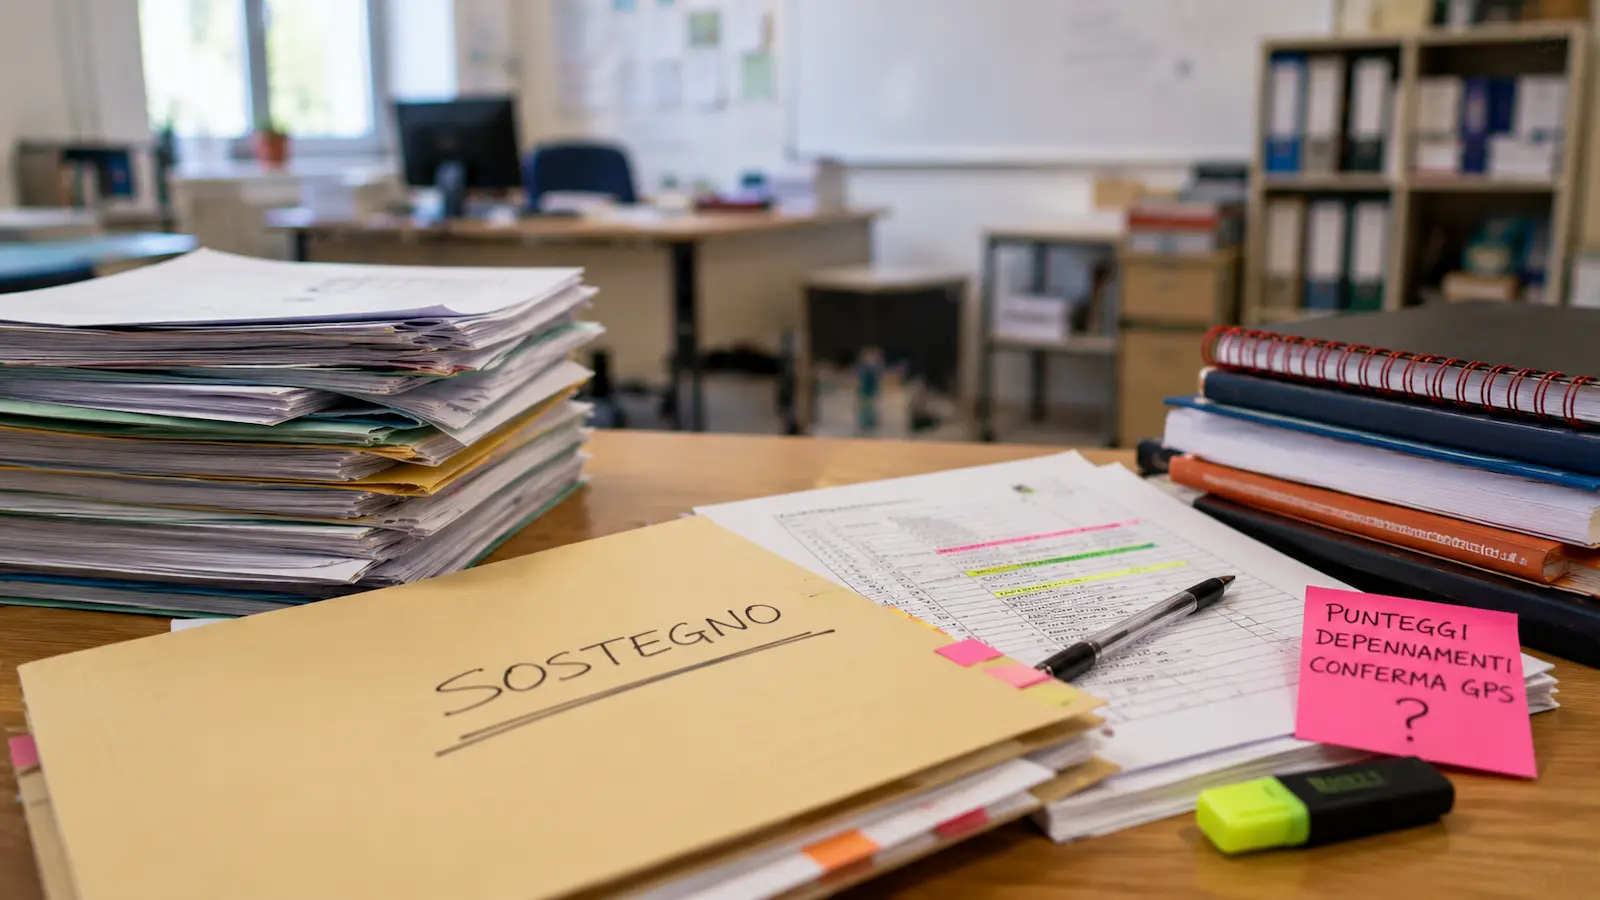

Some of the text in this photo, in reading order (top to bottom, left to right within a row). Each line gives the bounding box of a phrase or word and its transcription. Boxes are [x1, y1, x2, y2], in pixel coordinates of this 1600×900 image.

[1326, 603, 1468, 640] PUNTEGGI
[435, 604, 781, 716] SOSTEGNO
[1316, 629, 1512, 673] DEPENNAMENTI
[1309, 657, 1514, 704] CONFERMA GPS
[1396, 697, 1429, 742] ?
